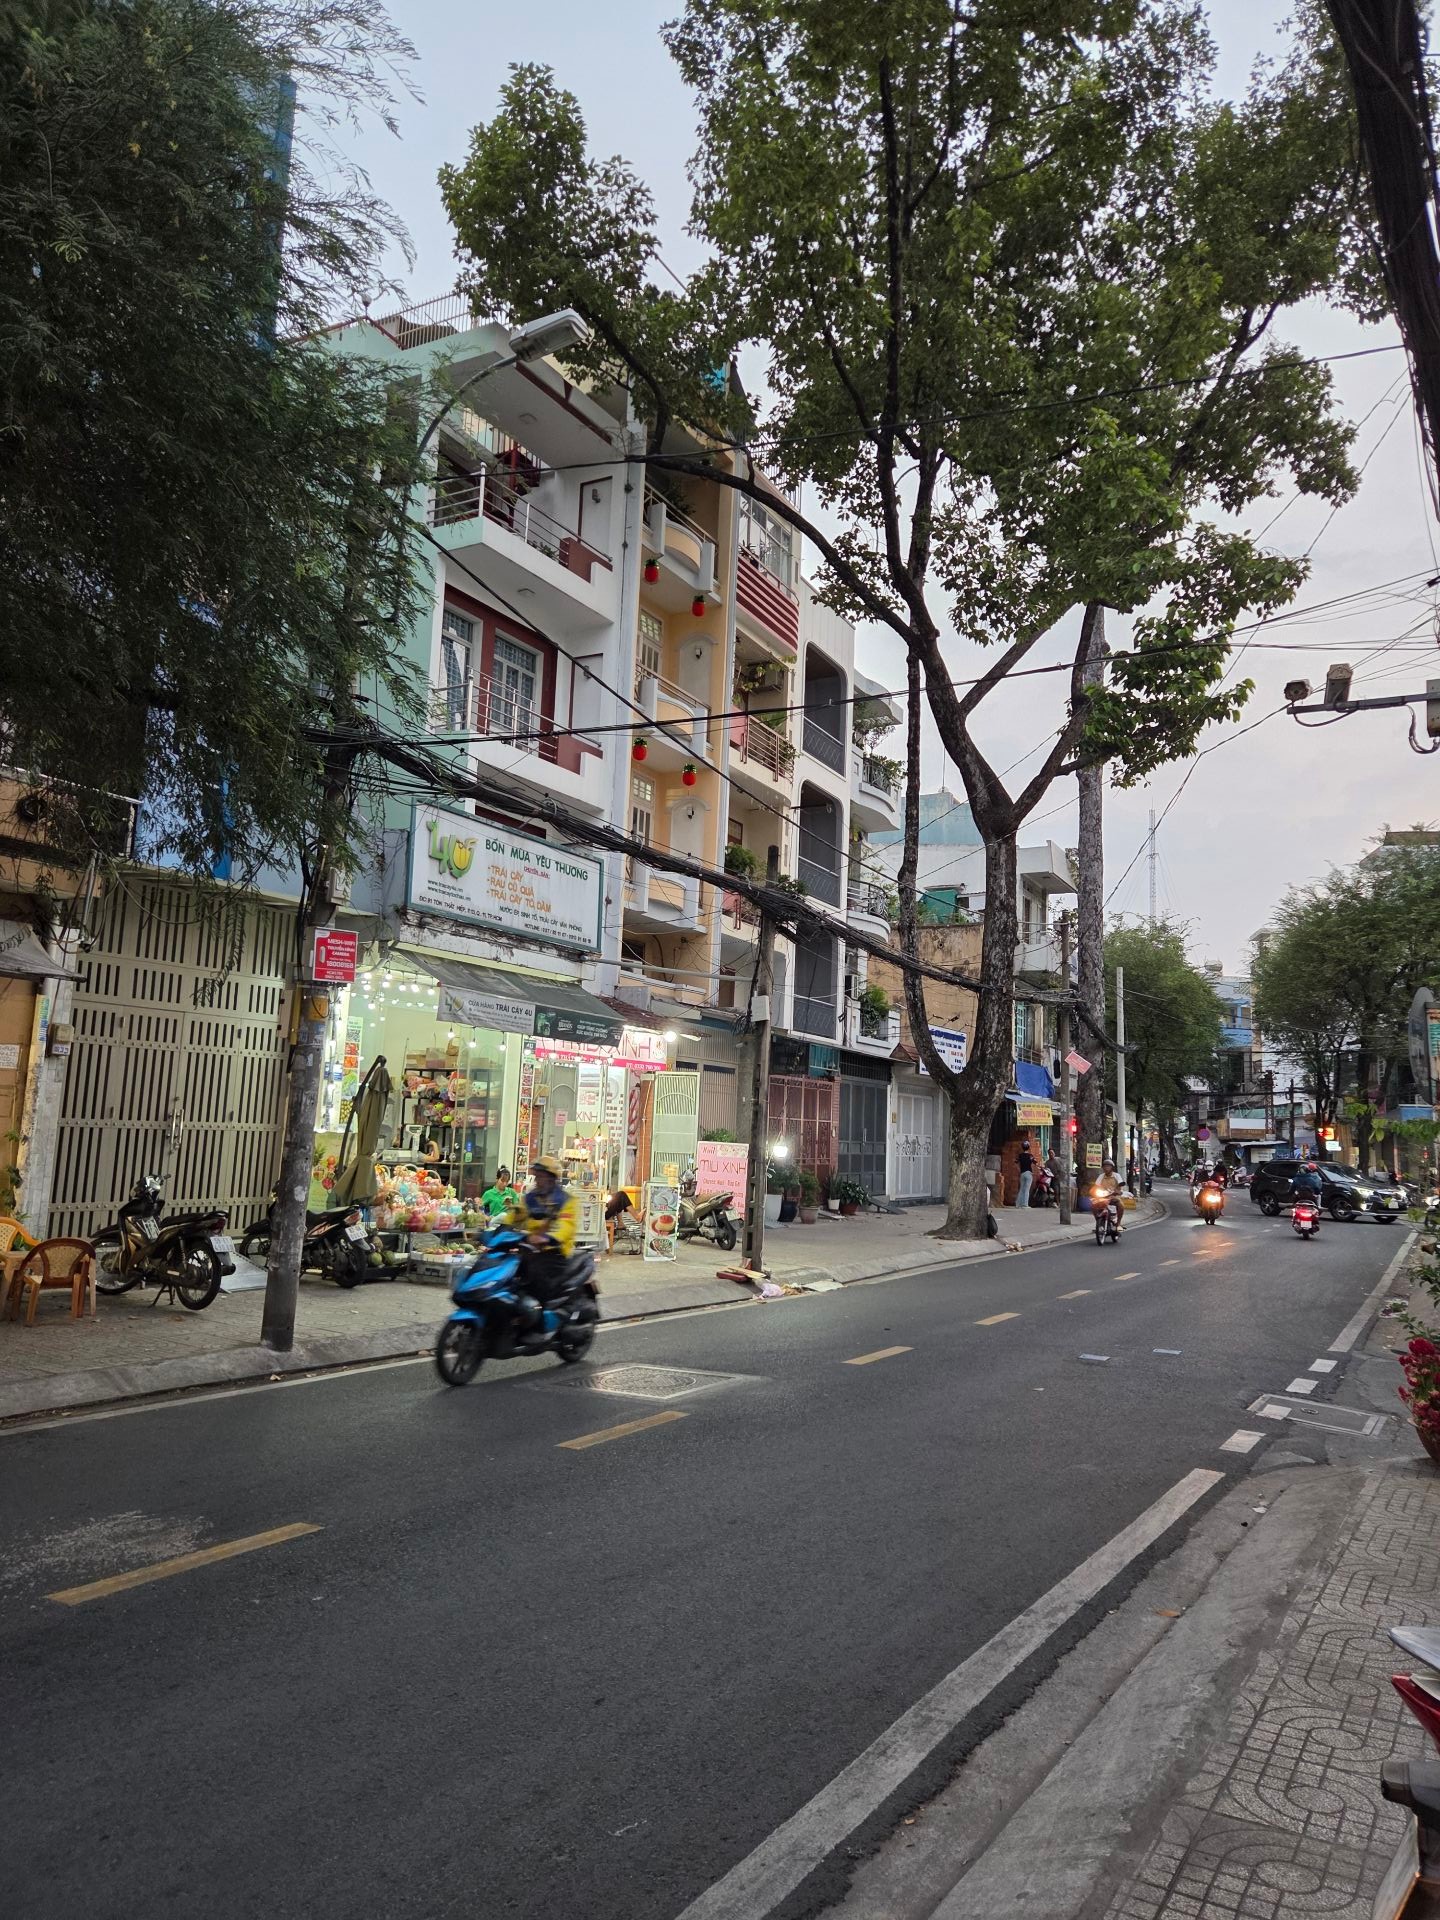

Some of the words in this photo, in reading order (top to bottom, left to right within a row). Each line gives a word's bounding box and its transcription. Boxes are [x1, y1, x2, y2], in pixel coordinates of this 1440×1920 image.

[485, 838, 505, 855] BỐN
[510, 847, 531, 863] MÙA
[535, 854, 551, 869] YÊU
[555, 860, 589, 881] THƯƠNG
[491, 865, 507, 878] TRÁI
[510, 871, 524, 883] CÂY
[491, 877, 506, 889] RAU
[490, 889, 506, 901] TRÁI
[509, 893, 523, 905] CÂY
[496, 1003, 510, 1013] TRÁI
[511, 1006, 524, 1015] CÂY
[524, 1008, 533, 1017] 4U
[722, 1160, 747, 1175] XINH
